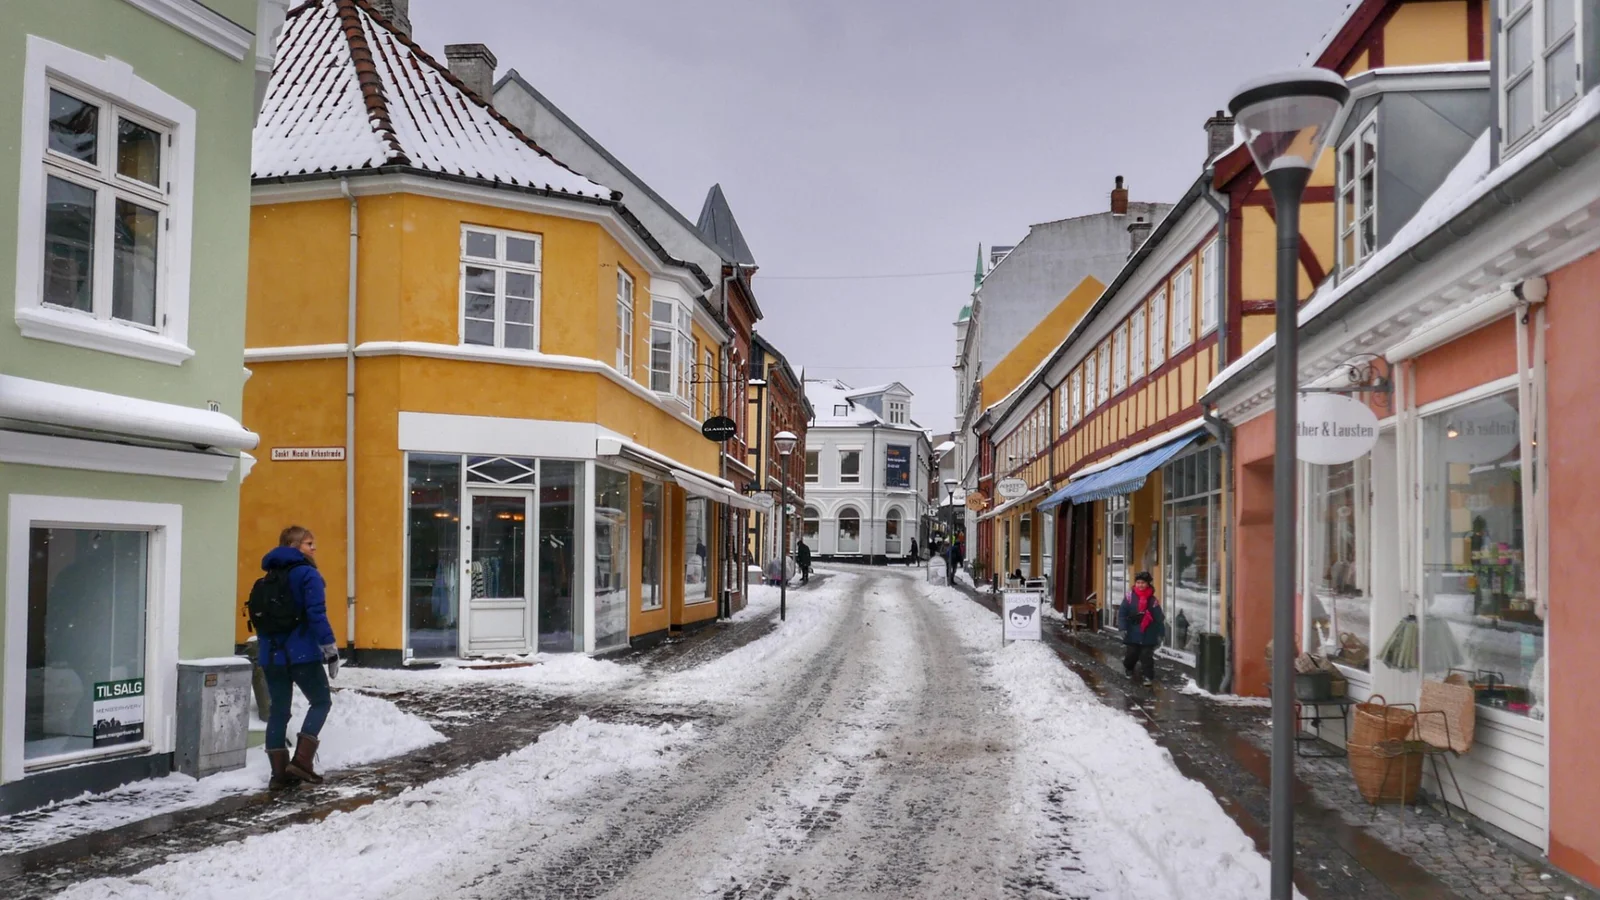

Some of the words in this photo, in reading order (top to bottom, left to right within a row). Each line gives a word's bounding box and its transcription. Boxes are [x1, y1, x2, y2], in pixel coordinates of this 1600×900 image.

[1321, 421, 1331, 437] &
[1332, 421, 1374, 438] Lausten
[274, 449, 289, 458] Sankt
[311, 449, 341, 458] Kirkestræde
[97, 686, 112, 697] TIL
[114, 682, 142, 695] SALG
